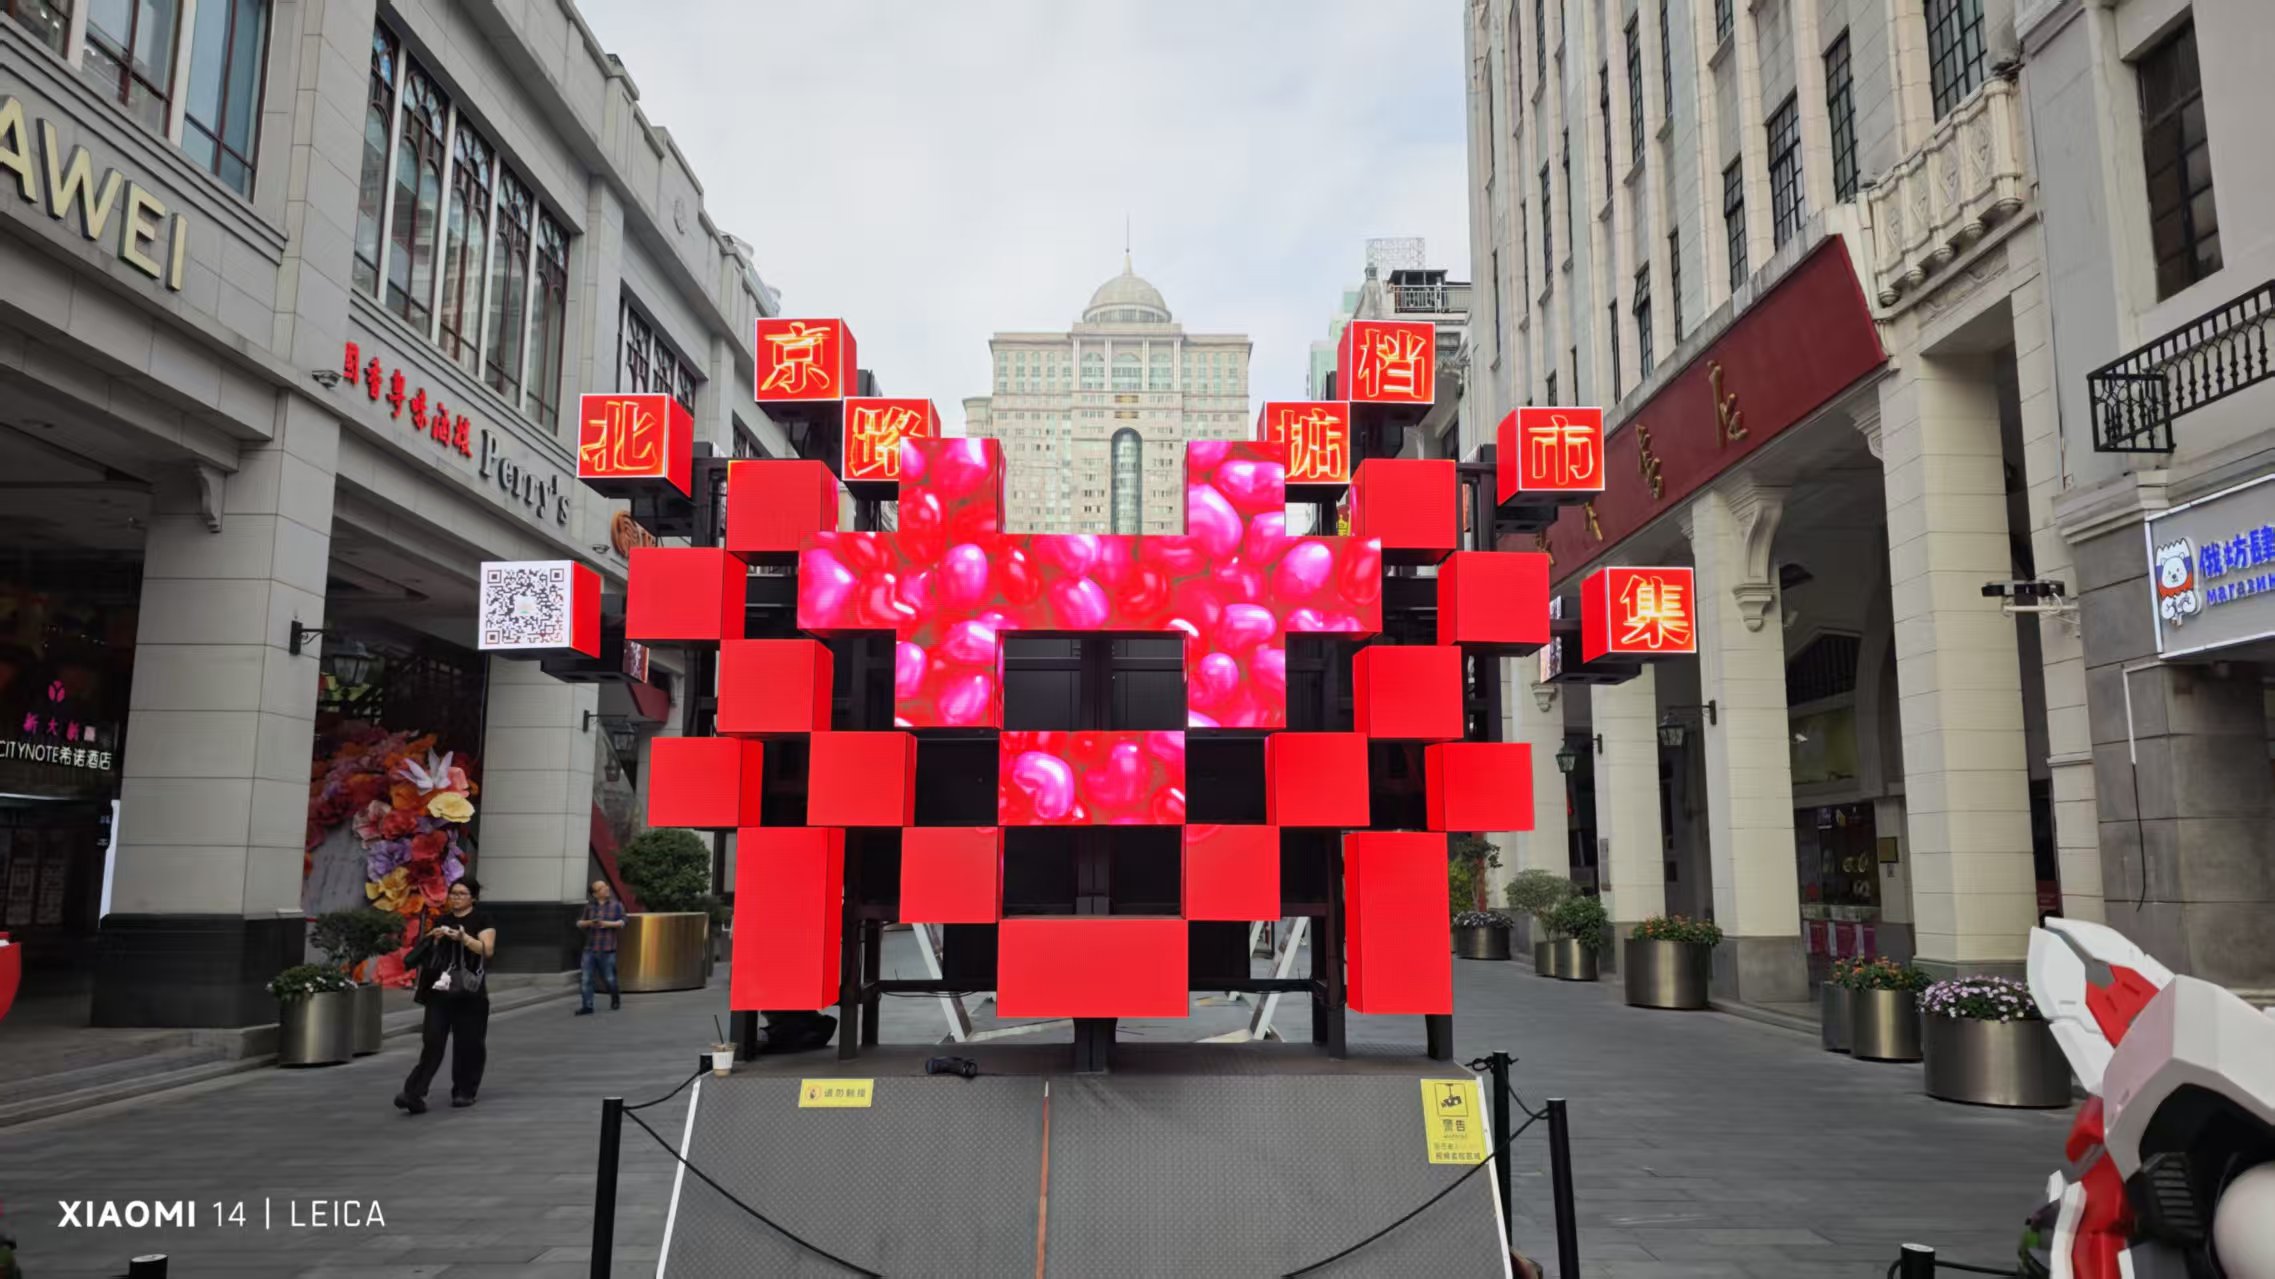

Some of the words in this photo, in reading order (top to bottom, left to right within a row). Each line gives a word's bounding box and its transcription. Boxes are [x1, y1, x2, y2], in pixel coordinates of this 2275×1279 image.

[760, 322, 831, 393] 京
[1358, 328, 1425, 398] 档
[580, 401, 658, 472] 北
[1527, 415, 1596, 486] 市
[479, 428, 570, 525] Perry's
[1620, 574, 1691, 649] 集
